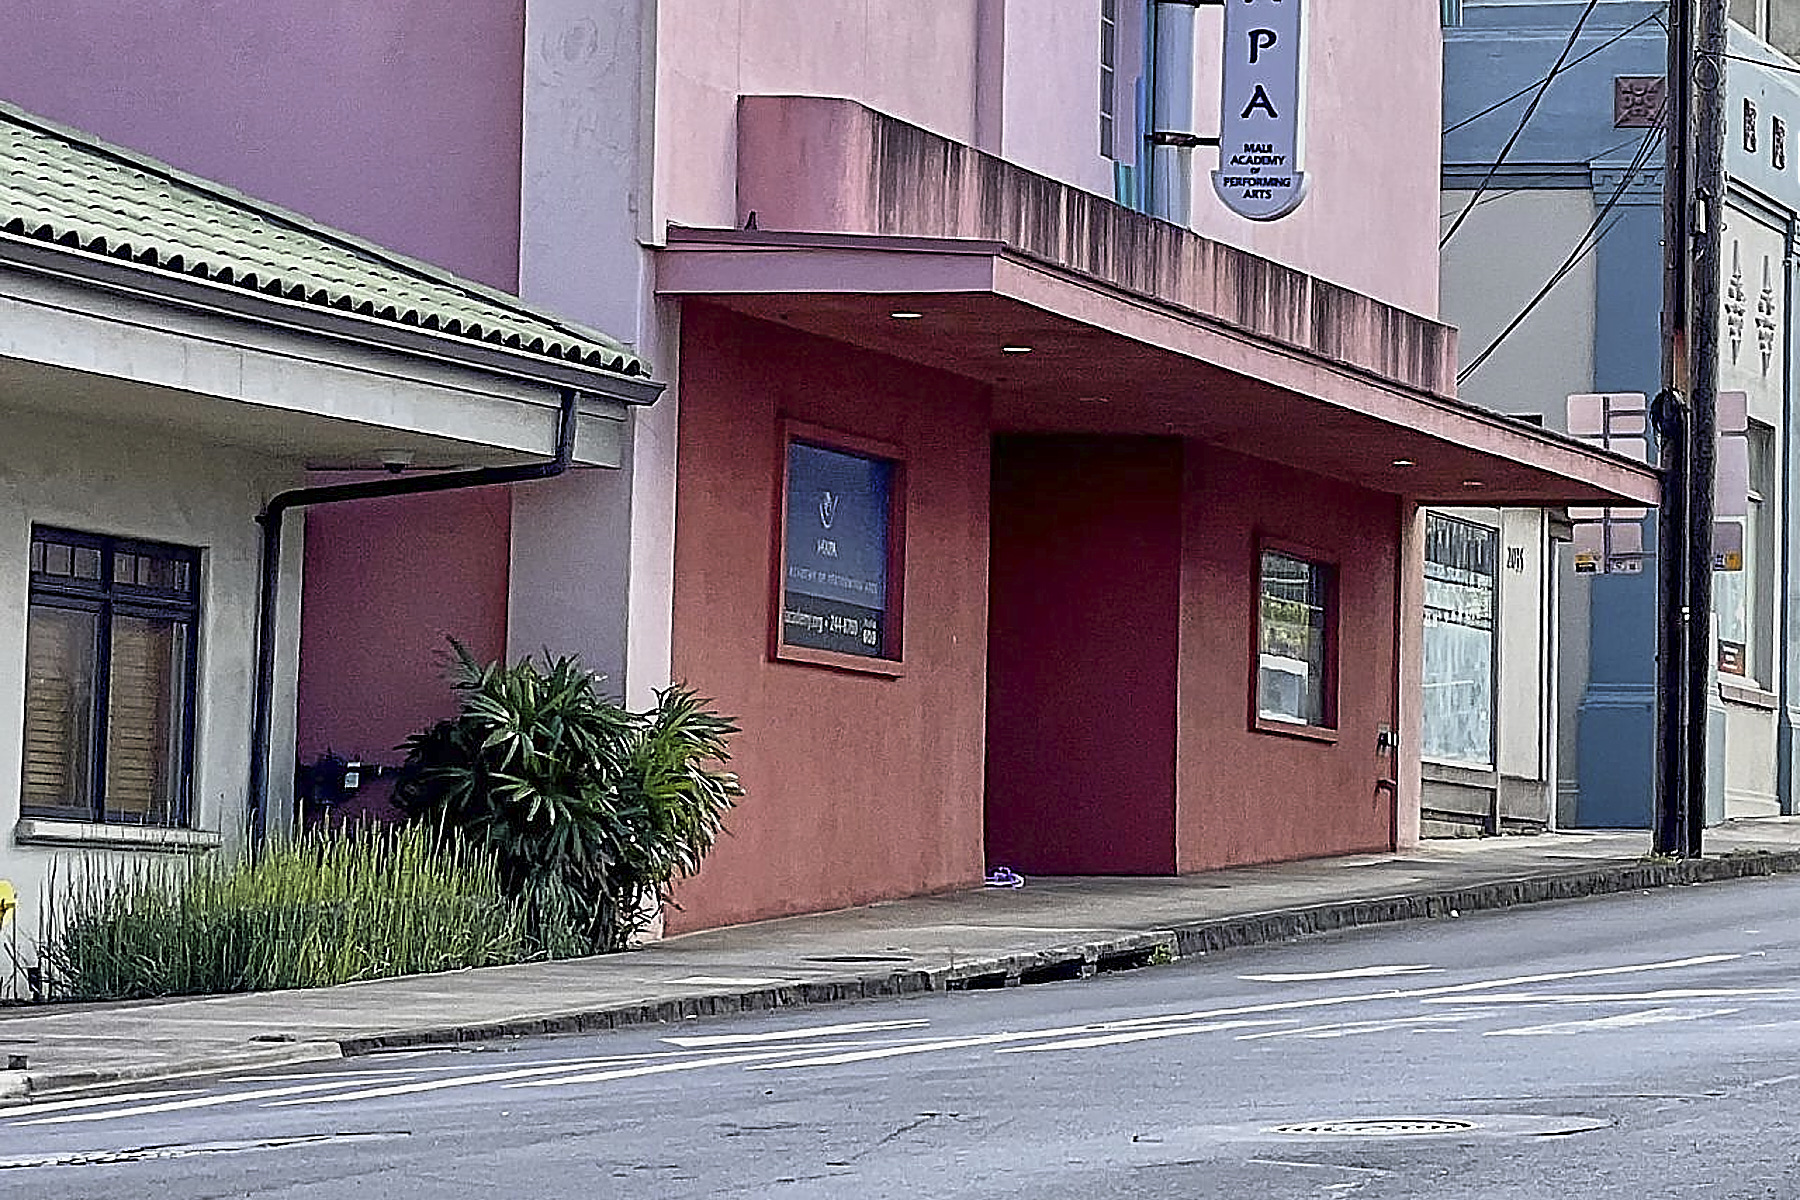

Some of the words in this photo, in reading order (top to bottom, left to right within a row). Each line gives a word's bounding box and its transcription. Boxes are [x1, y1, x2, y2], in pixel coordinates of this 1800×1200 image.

[1243, 143, 1273, 153] MAUI
[1230, 155, 1286, 166] ACADEMY
[1223, 177, 1291, 187] PERFORMING
[1243, 189, 1272, 199] ARTS
